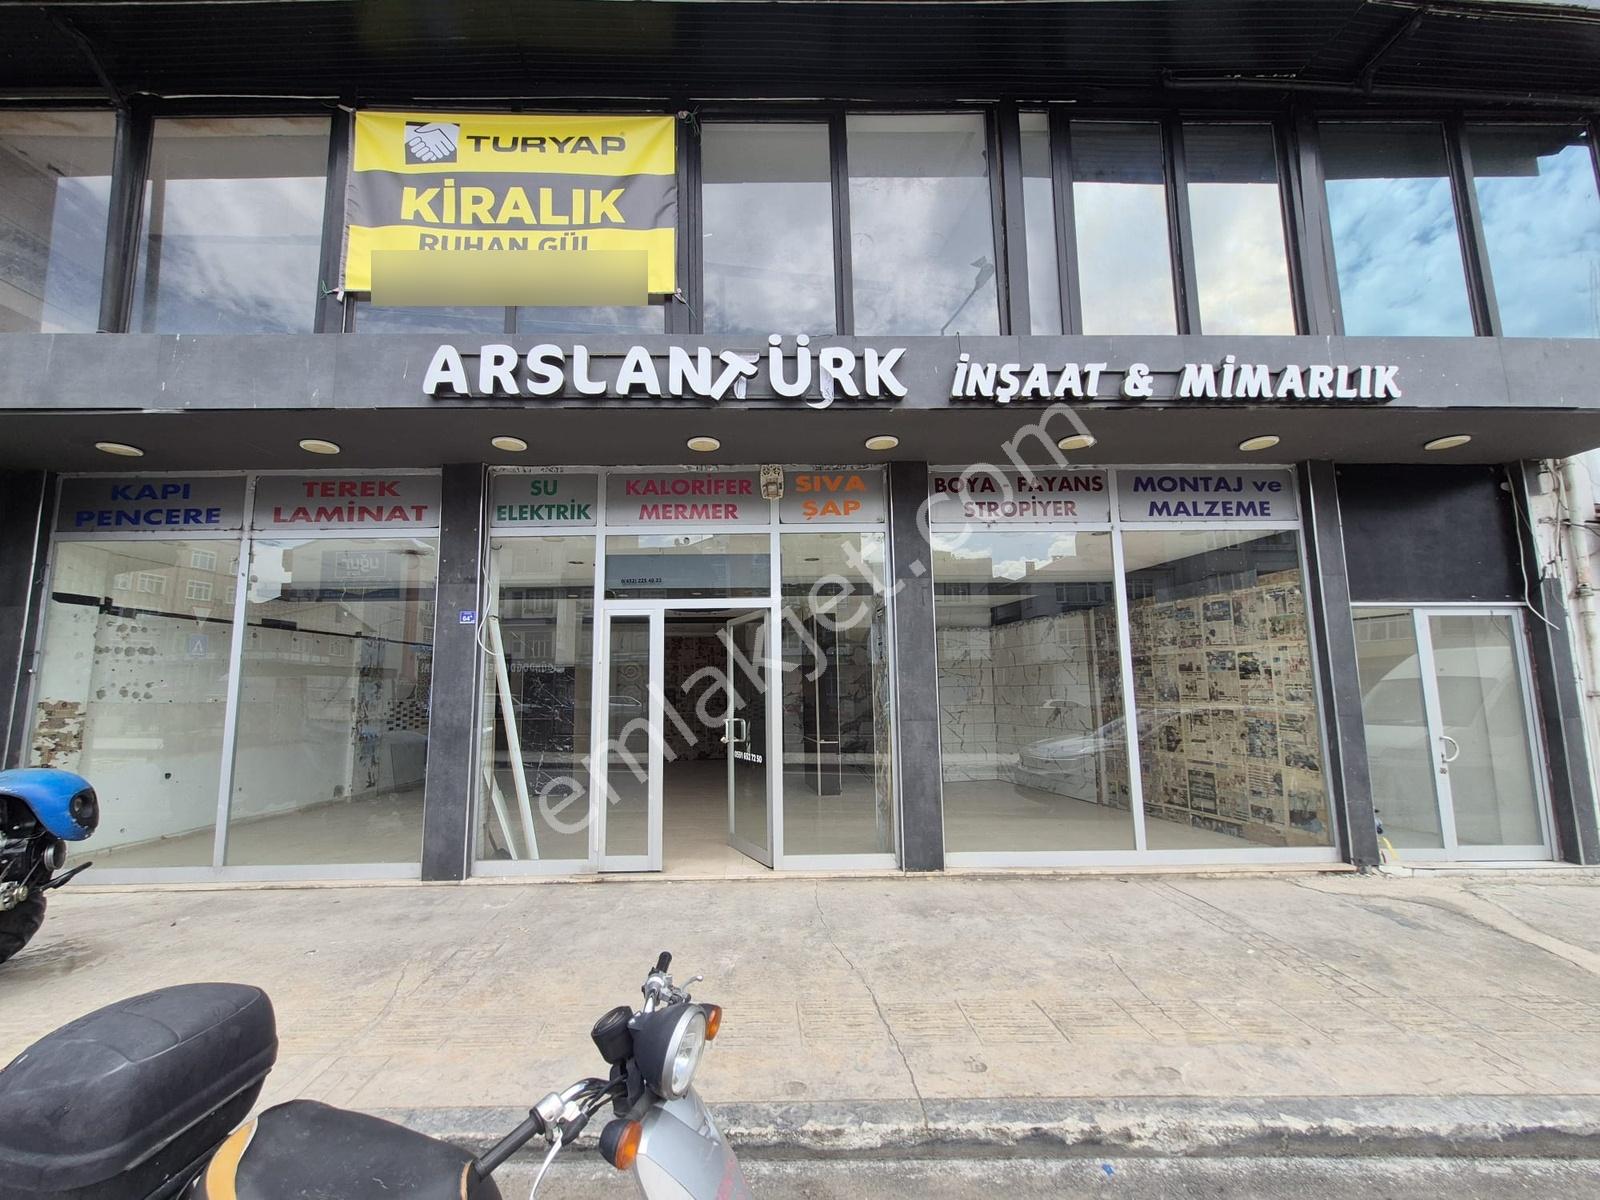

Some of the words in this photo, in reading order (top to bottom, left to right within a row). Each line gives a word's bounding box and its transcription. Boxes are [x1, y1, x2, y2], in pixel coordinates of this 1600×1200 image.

[466, 135, 626, 156] TURYAP
[400, 178, 625, 225] KİRALIK
[422, 334, 908, 404] ARSLANTÜRK
[951, 353, 1107, 403] İNŞAAT
[1123, 363, 1153, 397] &
[1178, 355, 1402, 399] MİMARLIK
[111, 483, 191, 501] KAPI
[303, 480, 401, 498] TEREK
[530, 479, 558, 497] SU
[625, 474, 753, 496] KALORİFER
[795, 475, 866, 493] SIVA
[934, 477, 996, 494] BOYA
[1017, 475, 1104, 493] FAYANS
[1133, 476, 1243, 493] MONTAJ
[1253, 480, 1282, 493] ve
[75, 507, 222, 527] PENCERE
[273, 500, 429, 523] LAMİNAT
[496, 499, 592, 521] ELEKTRİK
[638, 503, 739, 520] MERMER
[802, 499, 862, 521] ŞAP
[964, 496, 1078, 518] STROPİYER
[1148, 500, 1272, 517] MALZEME
